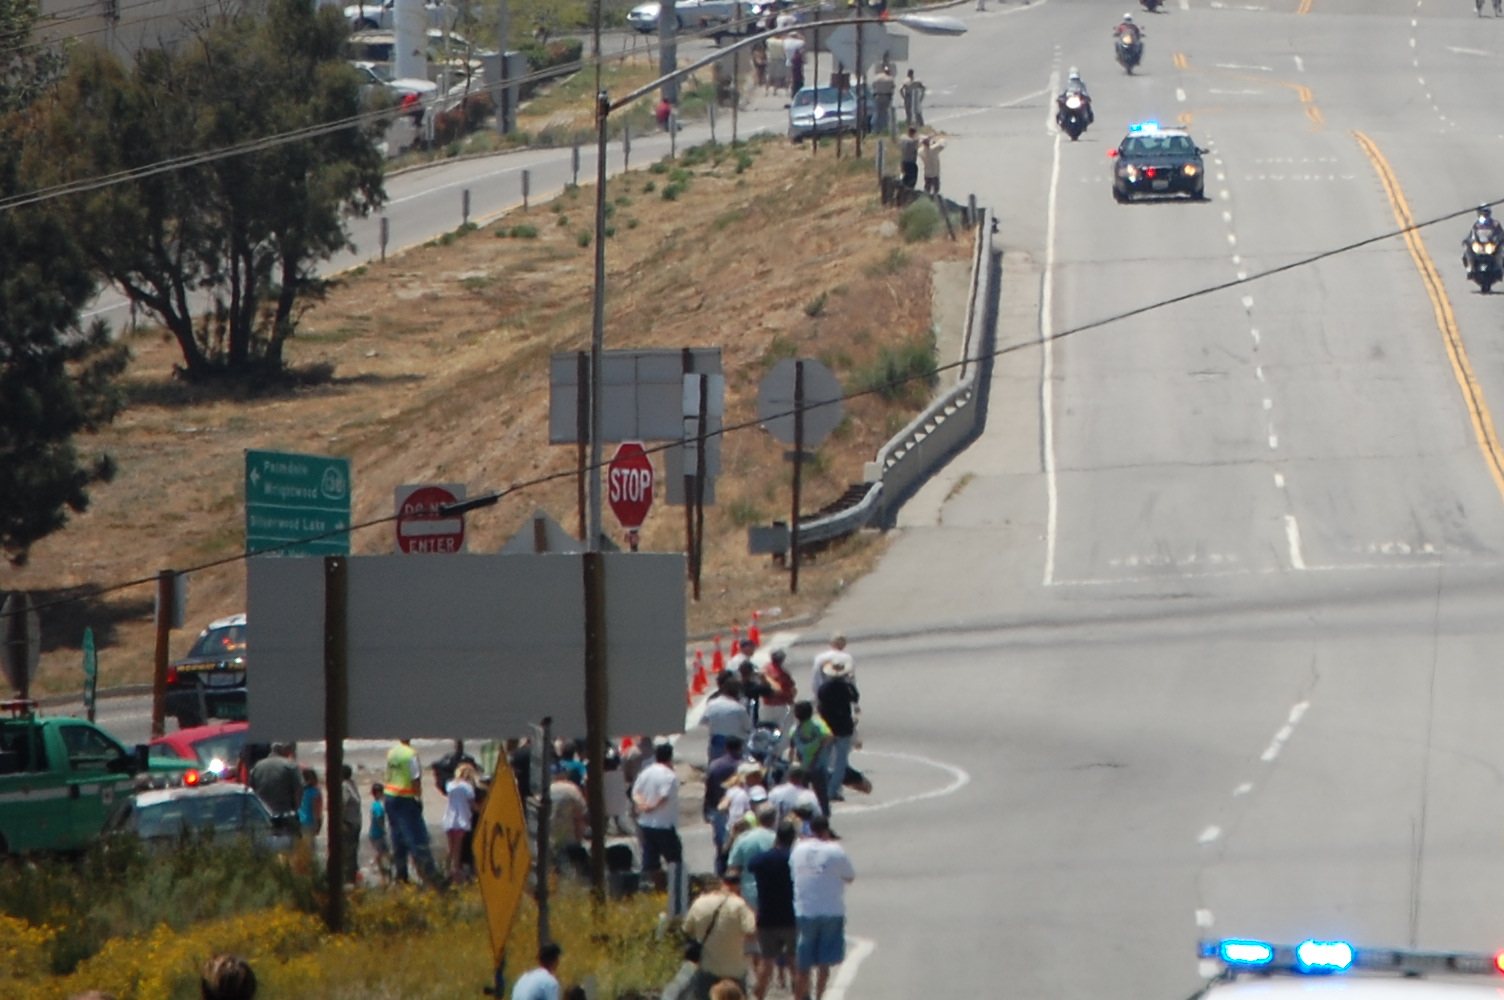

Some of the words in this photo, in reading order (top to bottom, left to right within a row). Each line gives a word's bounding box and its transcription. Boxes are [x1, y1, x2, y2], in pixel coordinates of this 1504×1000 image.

[609, 468, 650, 502] STOP
[404, 504, 424, 519] DO
[302, 518, 326, 531] Lake
[409, 537, 456, 553] ENTER
[481, 819, 520, 882] ICY
